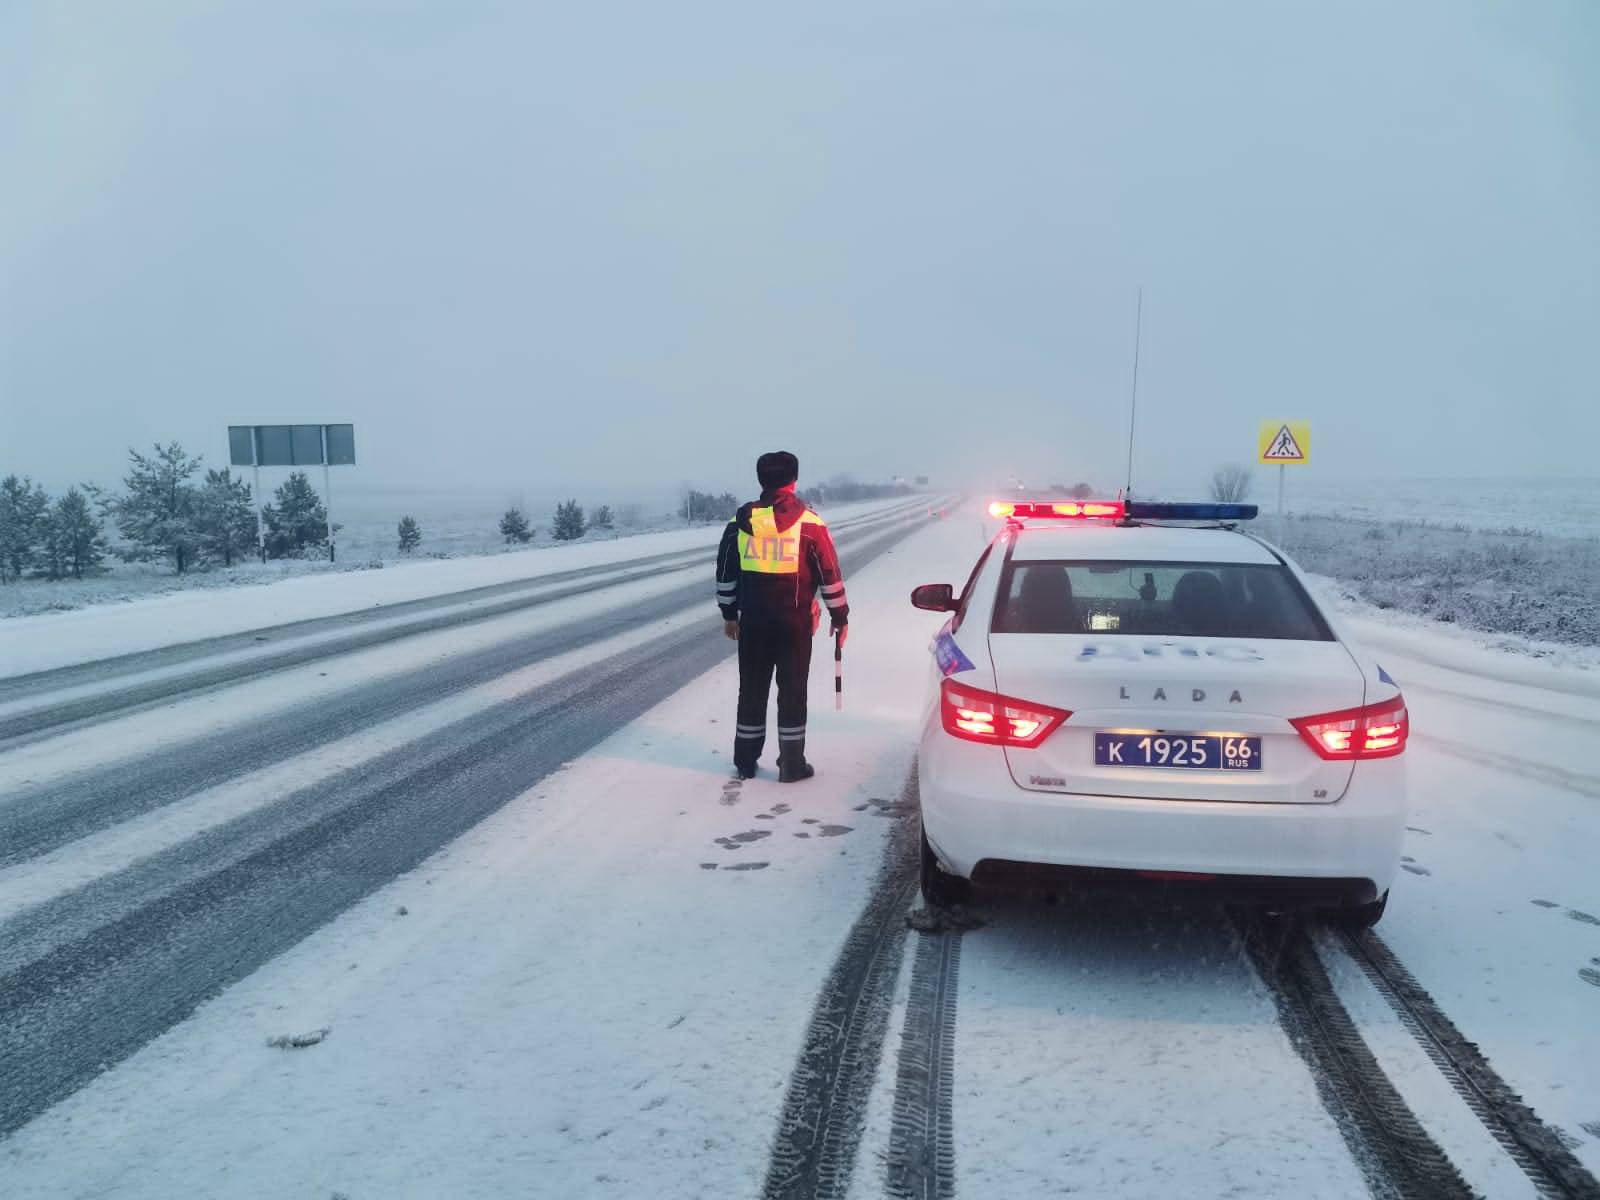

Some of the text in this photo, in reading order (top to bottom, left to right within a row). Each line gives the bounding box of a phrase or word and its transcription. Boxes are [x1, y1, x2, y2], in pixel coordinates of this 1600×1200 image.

[744, 537, 795, 561] ДПС
[1120, 686, 1242, 703] LADA
[1137, 737, 1207, 765] 1925
[1224, 738, 1251, 759] 66
[1228, 759, 1249, 768] RUS
